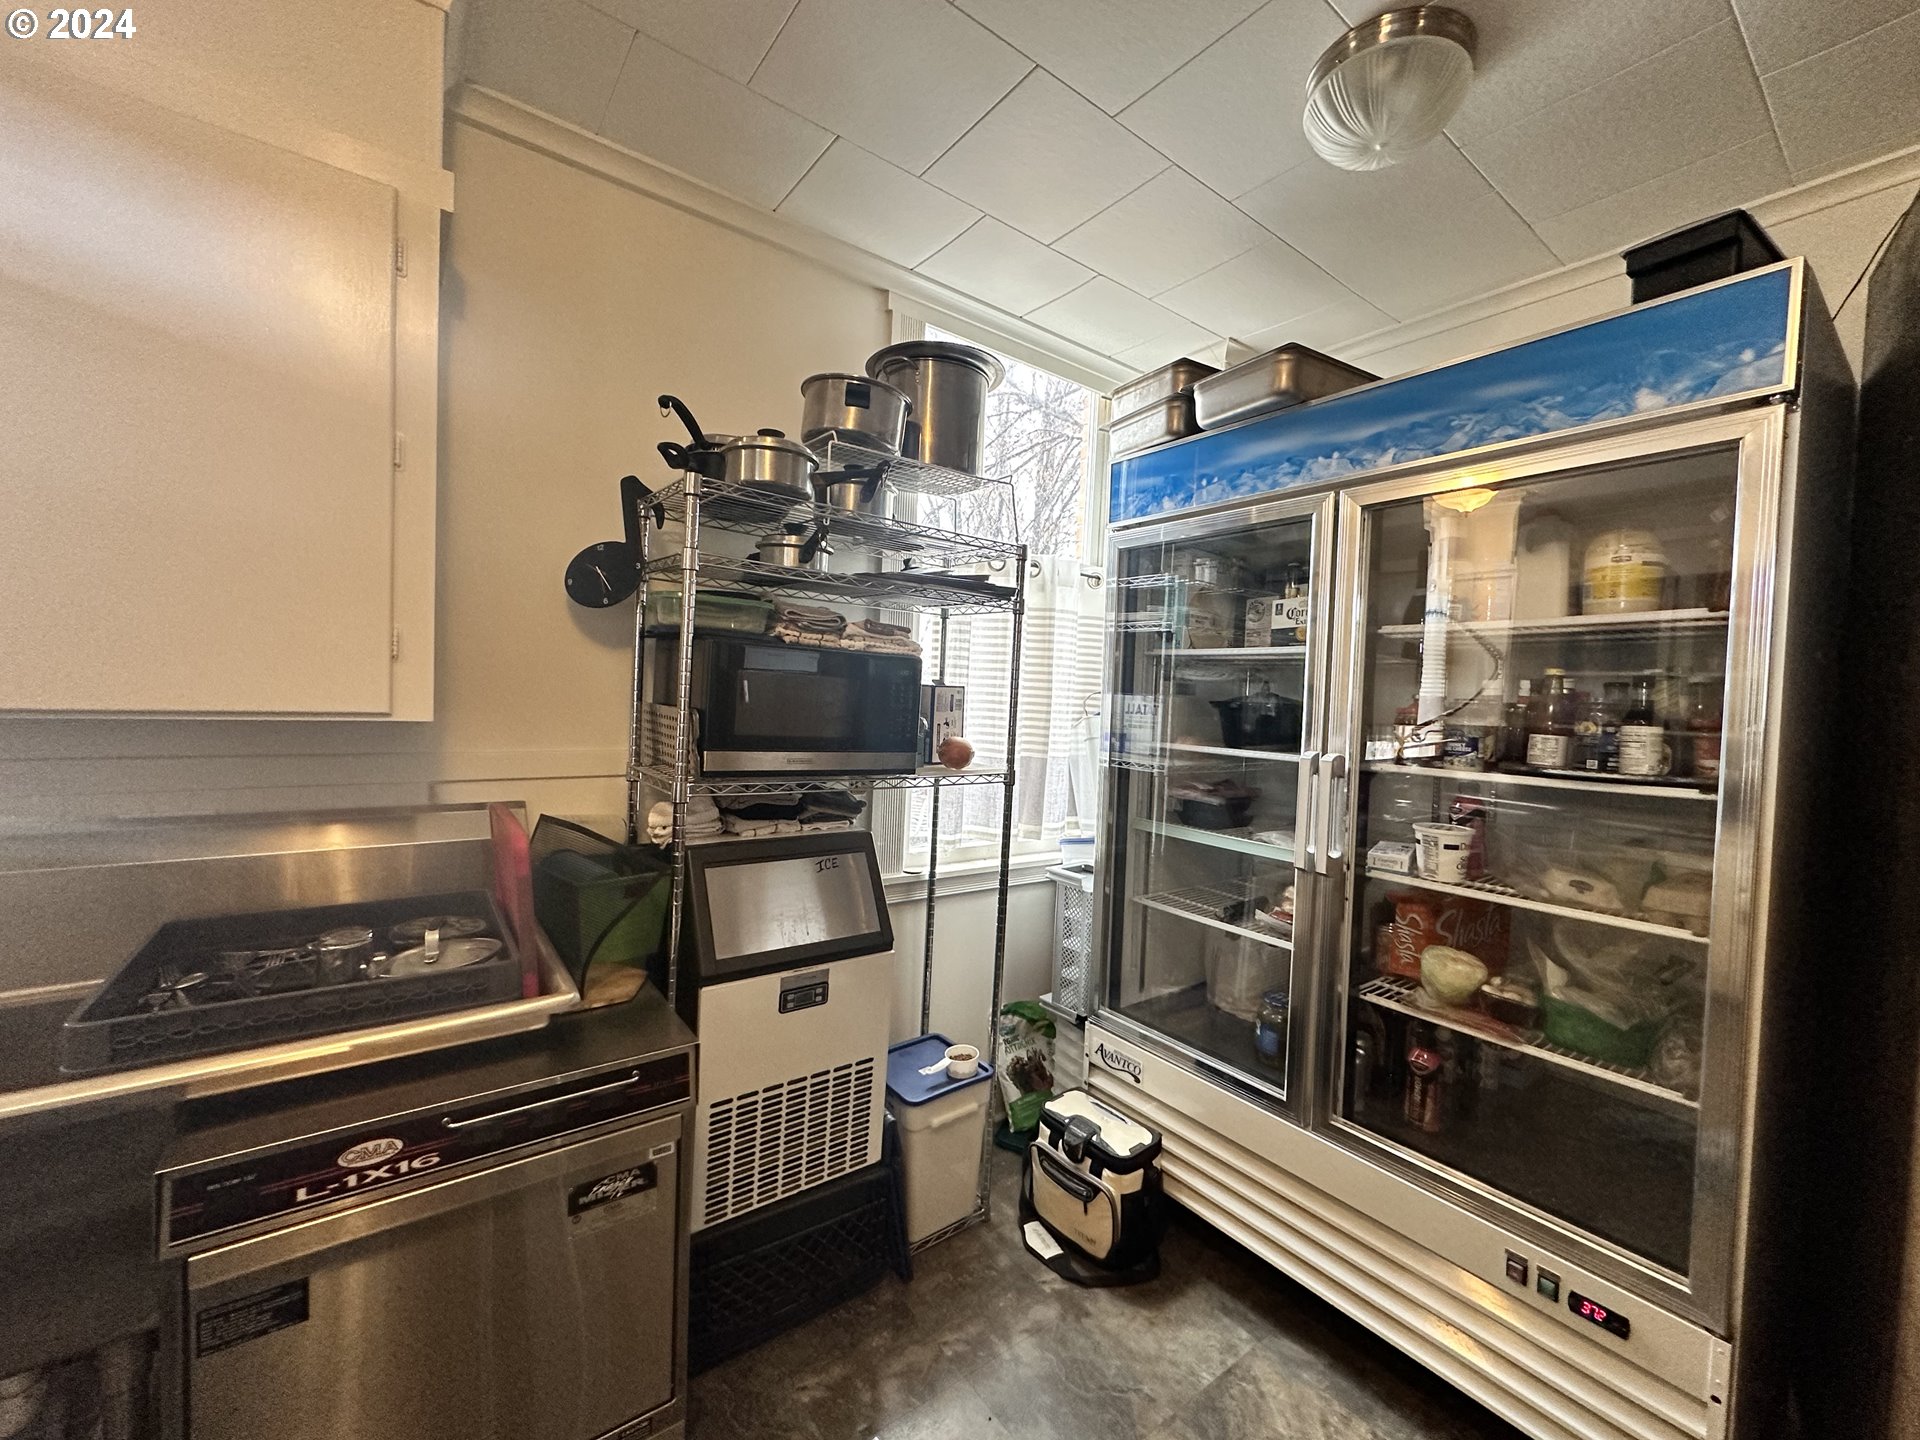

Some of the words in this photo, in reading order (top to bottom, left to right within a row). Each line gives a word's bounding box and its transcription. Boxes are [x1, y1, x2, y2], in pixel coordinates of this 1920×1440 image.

[635, 562, 641, 570] 3
[603, 597, 609, 605] 6
[815, 857, 840, 873] ICE
[1394, 911, 1424, 964] Shasta
[1436, 904, 1502, 948] Shasta
[1095, 1043, 1142, 1083] AVANTCO
[340, 1139, 401, 1165] CMA
[296, 1152, 441, 1202] L-1X16
